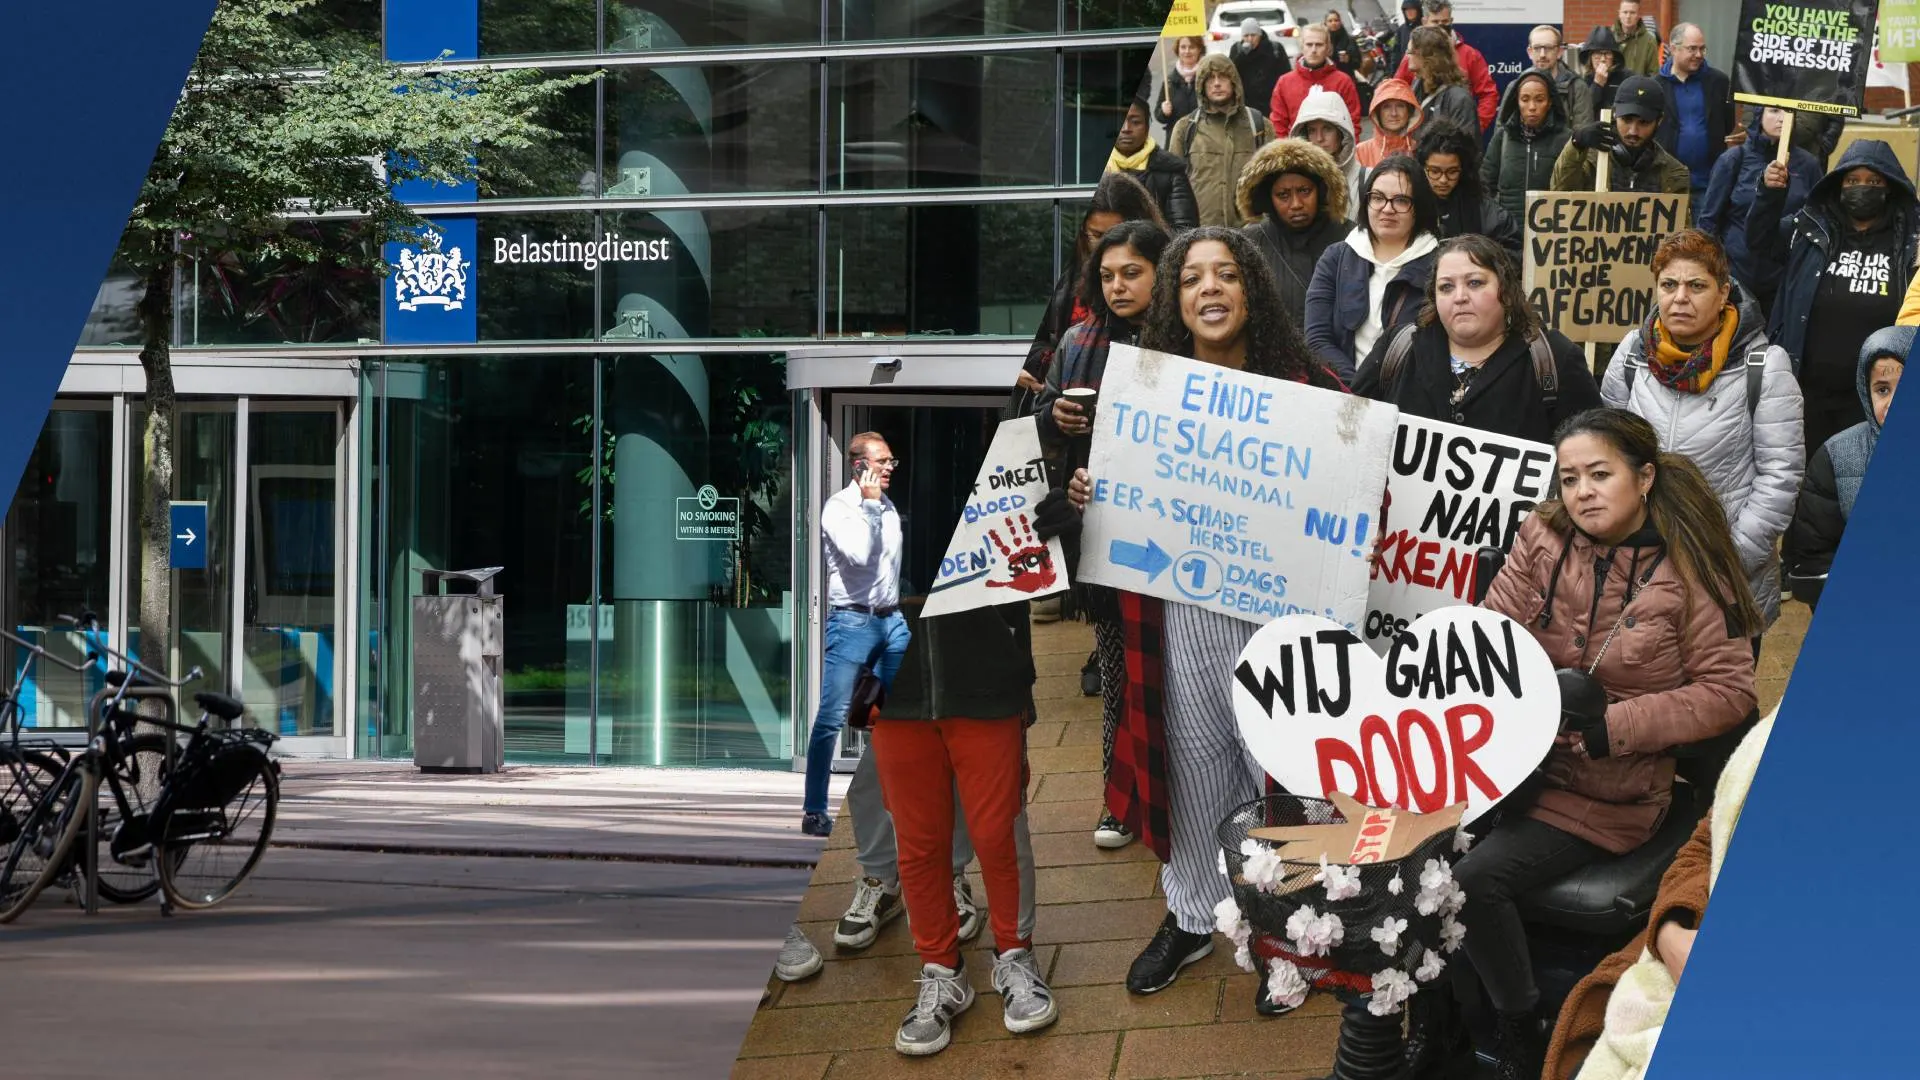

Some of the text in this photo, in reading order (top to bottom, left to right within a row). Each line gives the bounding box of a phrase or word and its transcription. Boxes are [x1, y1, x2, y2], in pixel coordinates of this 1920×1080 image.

[1166, 15, 1198, 26] ECHTEN
[1766, 3, 1850, 27] YOU HAVE
[1752, 17, 1821, 40] CHOSEN
[1824, 24, 1859, 44] THE
[1752, 32, 1854, 58] SIDE OF THE
[1497, 61, 1522, 74] Zuid
[1750, 47, 1851, 73] OPPRESSOR
[1797, 102, 1840, 114] ROTTERDAM
[1528, 197, 1679, 233] GEZINNEN
[493, 232, 670, 271] Belastingdienst
[1826, 262, 1890, 282] AARDIG
[1849, 278, 1889, 296] BIJ1
[1112, 402, 1312, 480] TOESLAGEN
[1155, 452, 1295, 509] SCHANDAAL
[680, 511, 736, 521] NO SMOKING
[963, 495, 1026, 524] BLOED
[1172, 497, 1249, 534] SCHADE
[680, 526, 735, 534] WITHIN 8 METERS
[1190, 527, 1274, 562] HERSTEL
[1225, 564, 1288, 598] DAGS
[1234, 619, 1523, 719] WIJ GAAN
[1315, 703, 1503, 815] DOOR
[1349, 814, 1392, 865] STOP
